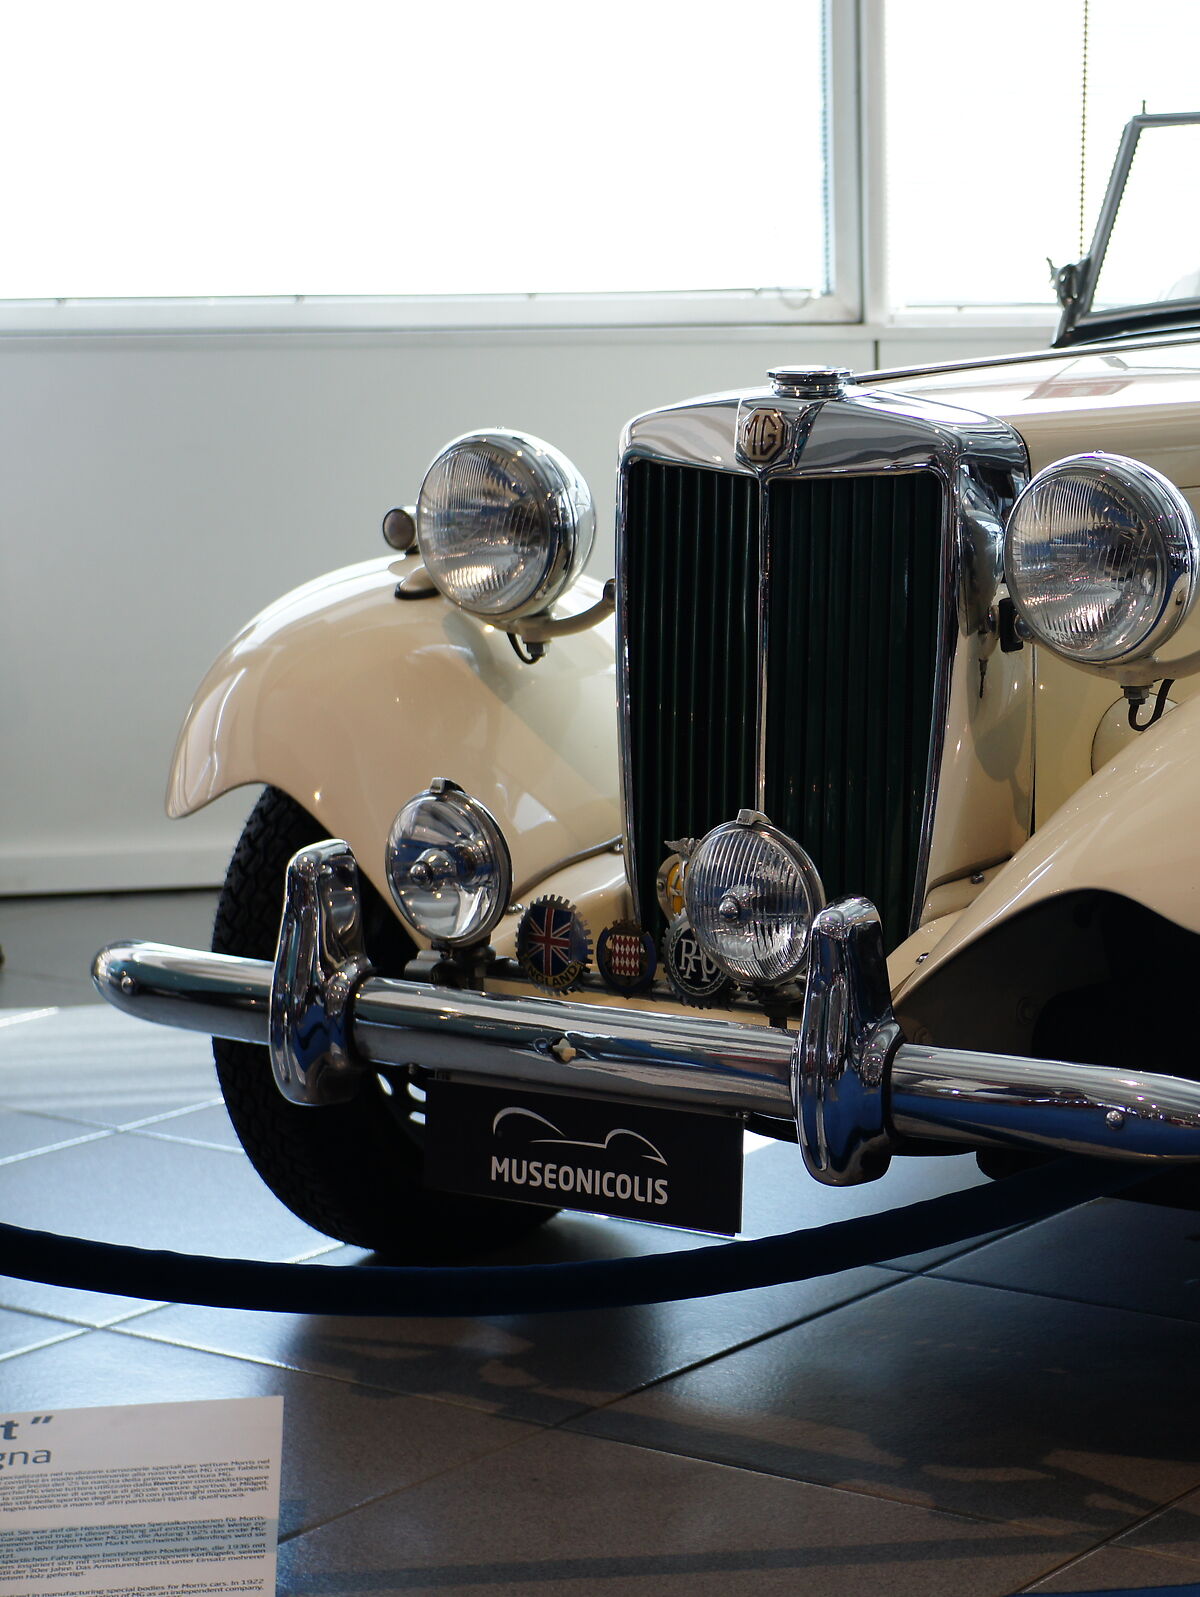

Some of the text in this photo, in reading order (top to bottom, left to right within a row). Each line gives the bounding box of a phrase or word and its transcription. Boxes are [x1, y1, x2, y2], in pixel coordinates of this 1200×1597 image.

[743, 413, 778, 457] MG
[527, 964, 579, 987] NGLAND
[490, 1156, 669, 1205] MUSEONICOLIS
